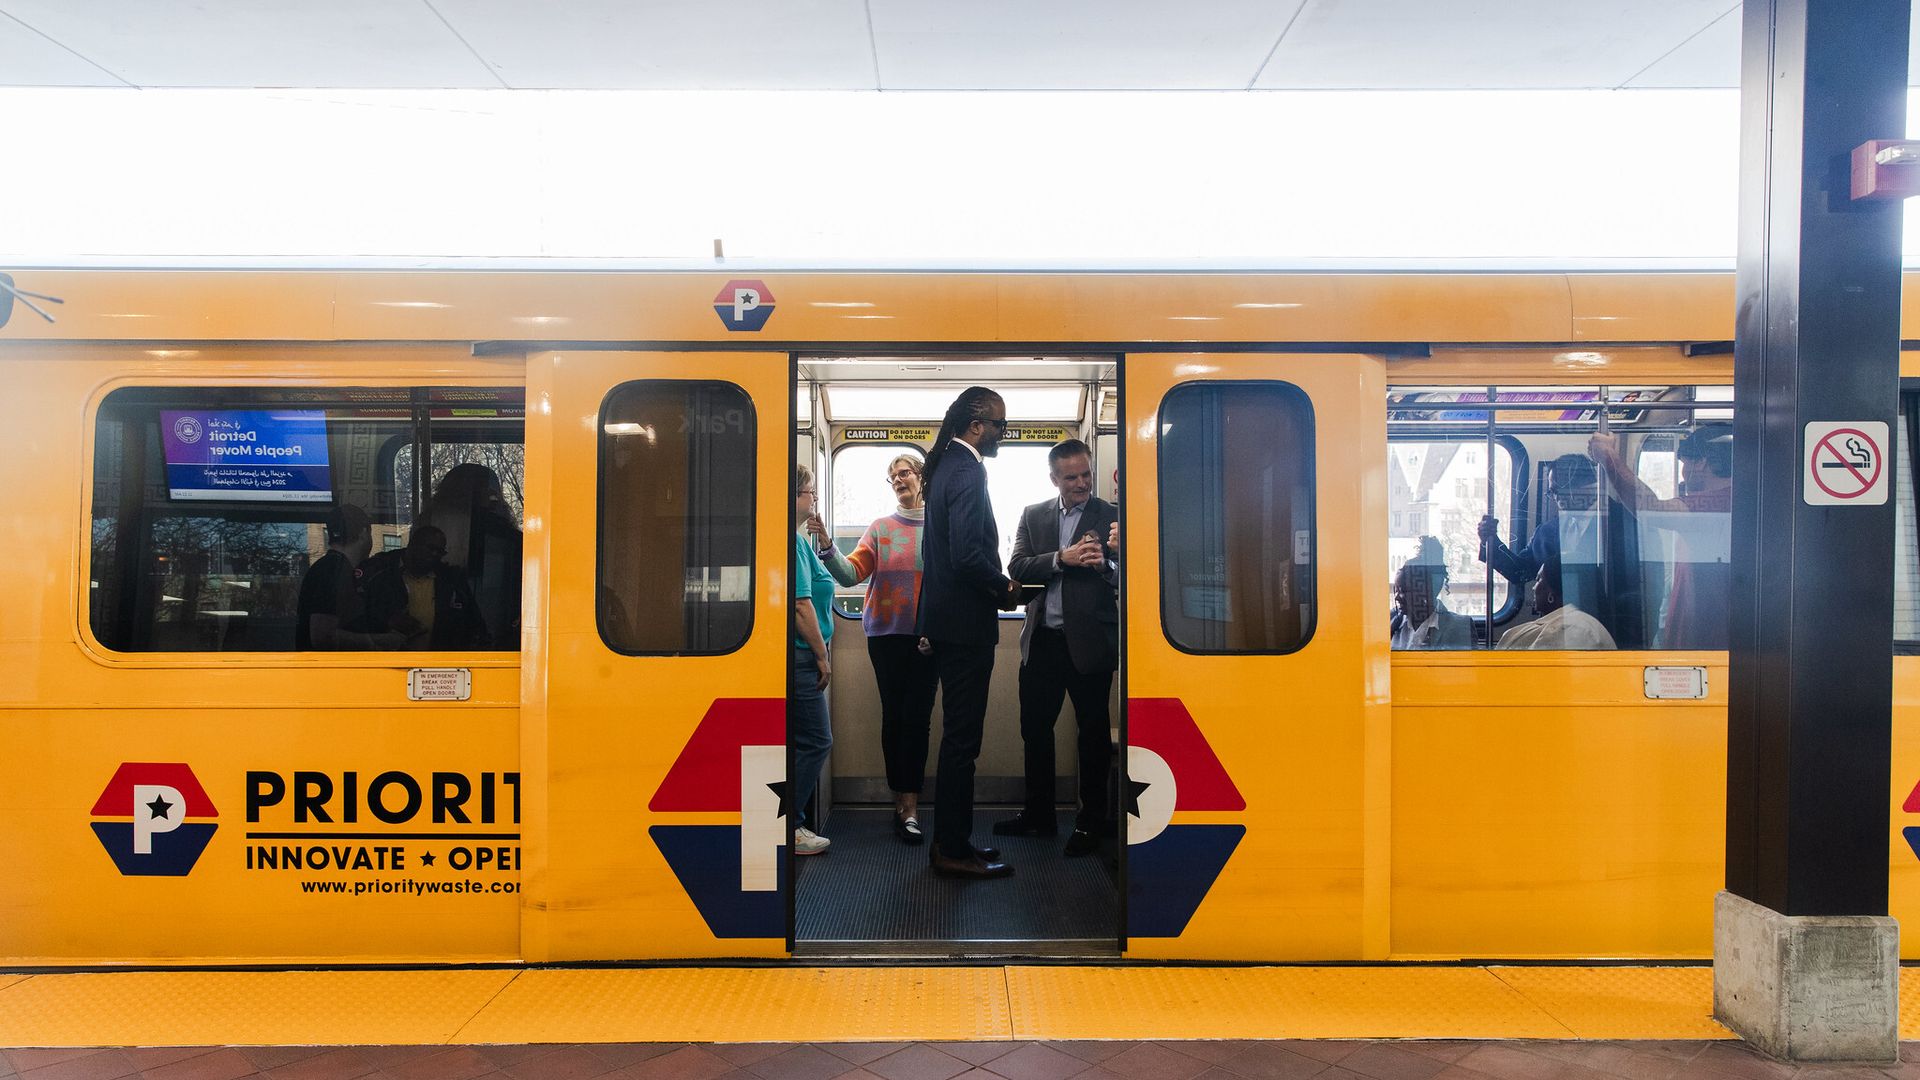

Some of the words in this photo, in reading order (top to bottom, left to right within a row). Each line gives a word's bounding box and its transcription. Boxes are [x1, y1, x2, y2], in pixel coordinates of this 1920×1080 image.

[734, 288, 761, 321] P
[846, 430, 887, 439] CAUTION
[133, 784, 187, 855] P
[246, 846, 406, 871] INNOVATE
[448, 846, 521, 871] OPE
[301, 877, 521, 896] www.prioritywaste.co
